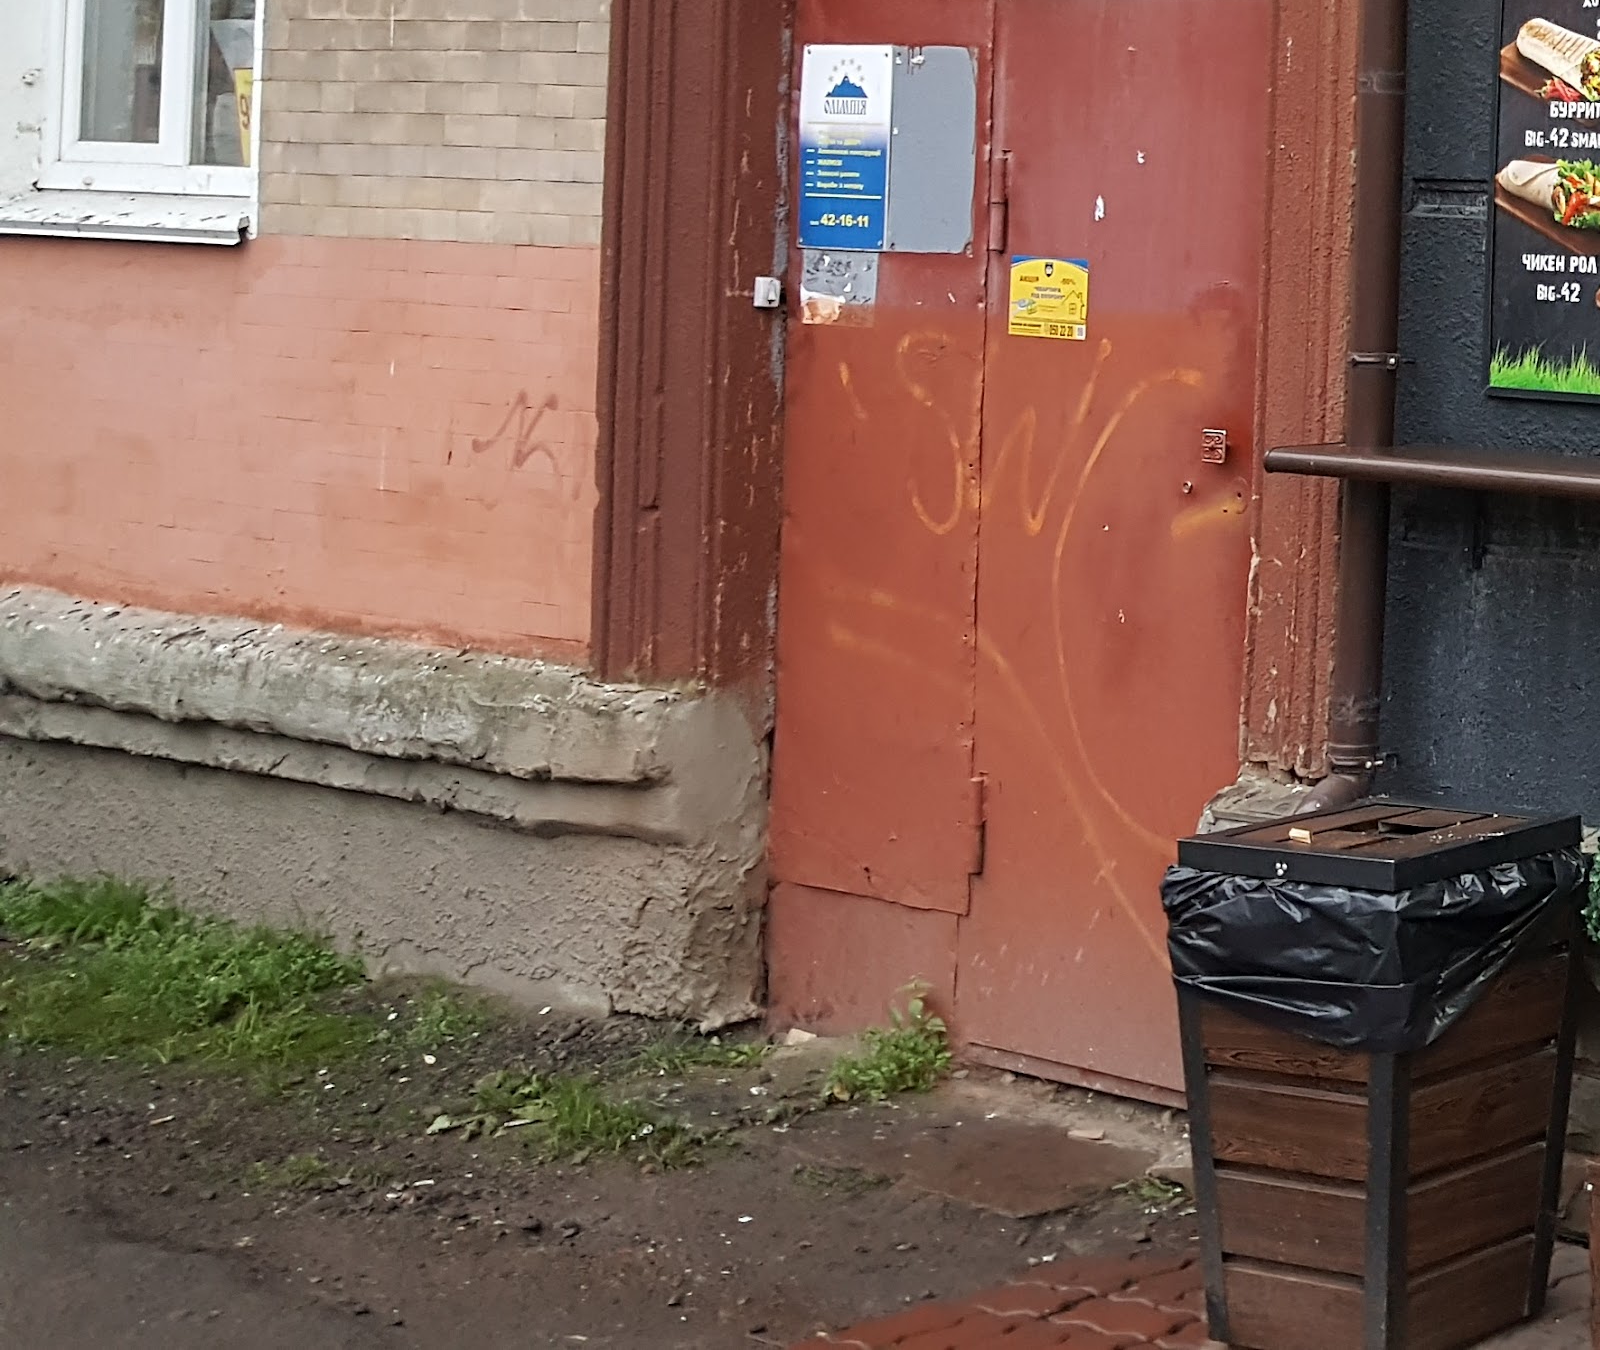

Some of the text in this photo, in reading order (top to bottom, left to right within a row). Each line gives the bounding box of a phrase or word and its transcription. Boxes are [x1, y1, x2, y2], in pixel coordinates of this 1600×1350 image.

[820, 214, 869, 227] 42-16-11
[1522, 254, 1598, 274] ЧИКЕН РОЛ
